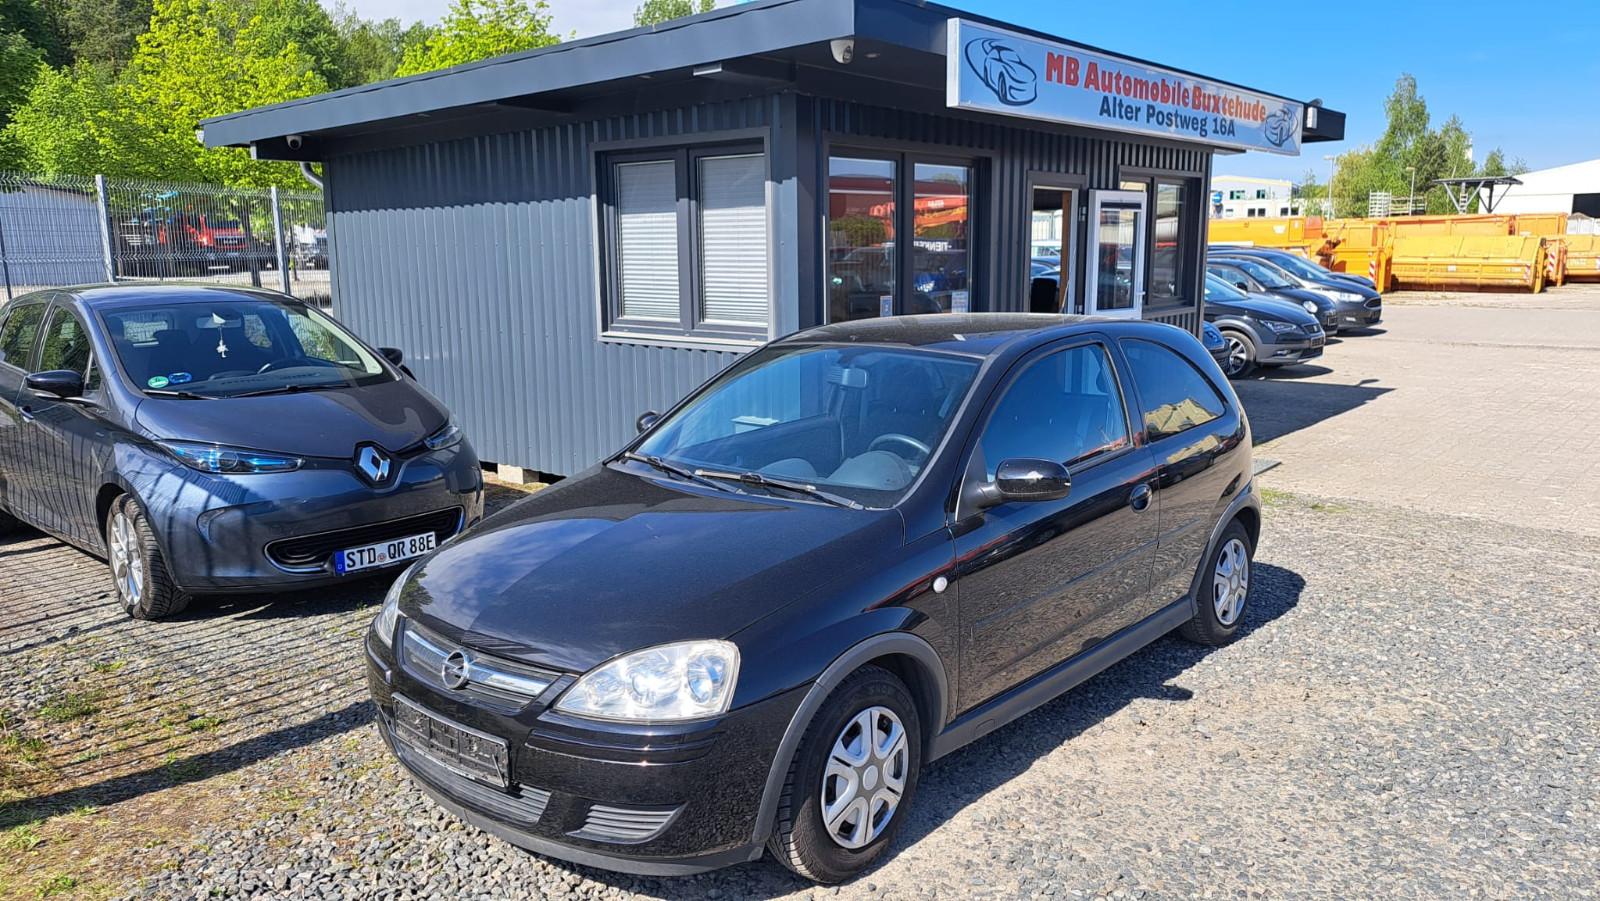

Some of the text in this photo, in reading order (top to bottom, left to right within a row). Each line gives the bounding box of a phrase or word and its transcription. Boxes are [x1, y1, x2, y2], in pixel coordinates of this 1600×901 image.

[1046, 52, 1266, 122] MB Automobile Buxtehude
[1099, 95, 1235, 137] Alter Postweg 16A
[346, 534, 435, 568] STD QR 88E
